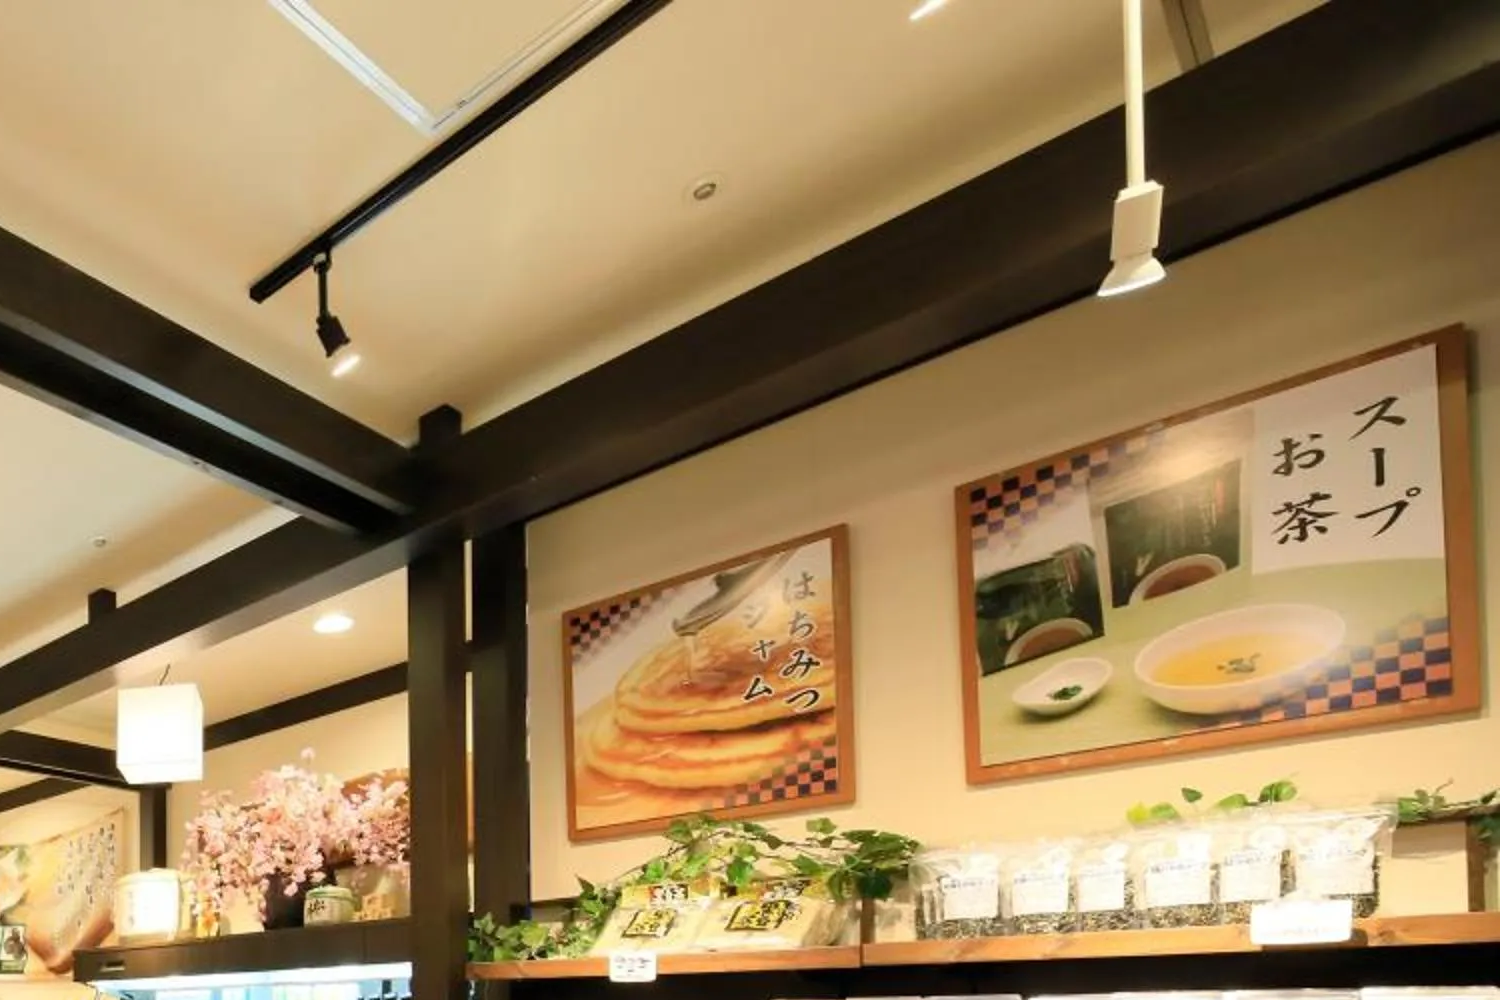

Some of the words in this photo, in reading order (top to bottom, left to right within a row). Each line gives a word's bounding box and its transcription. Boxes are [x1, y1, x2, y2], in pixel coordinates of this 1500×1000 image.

[1270, 432, 1340, 545] お茶
[1348, 395, 1422, 539] スープ
[782, 570, 821, 709] はちみつ
